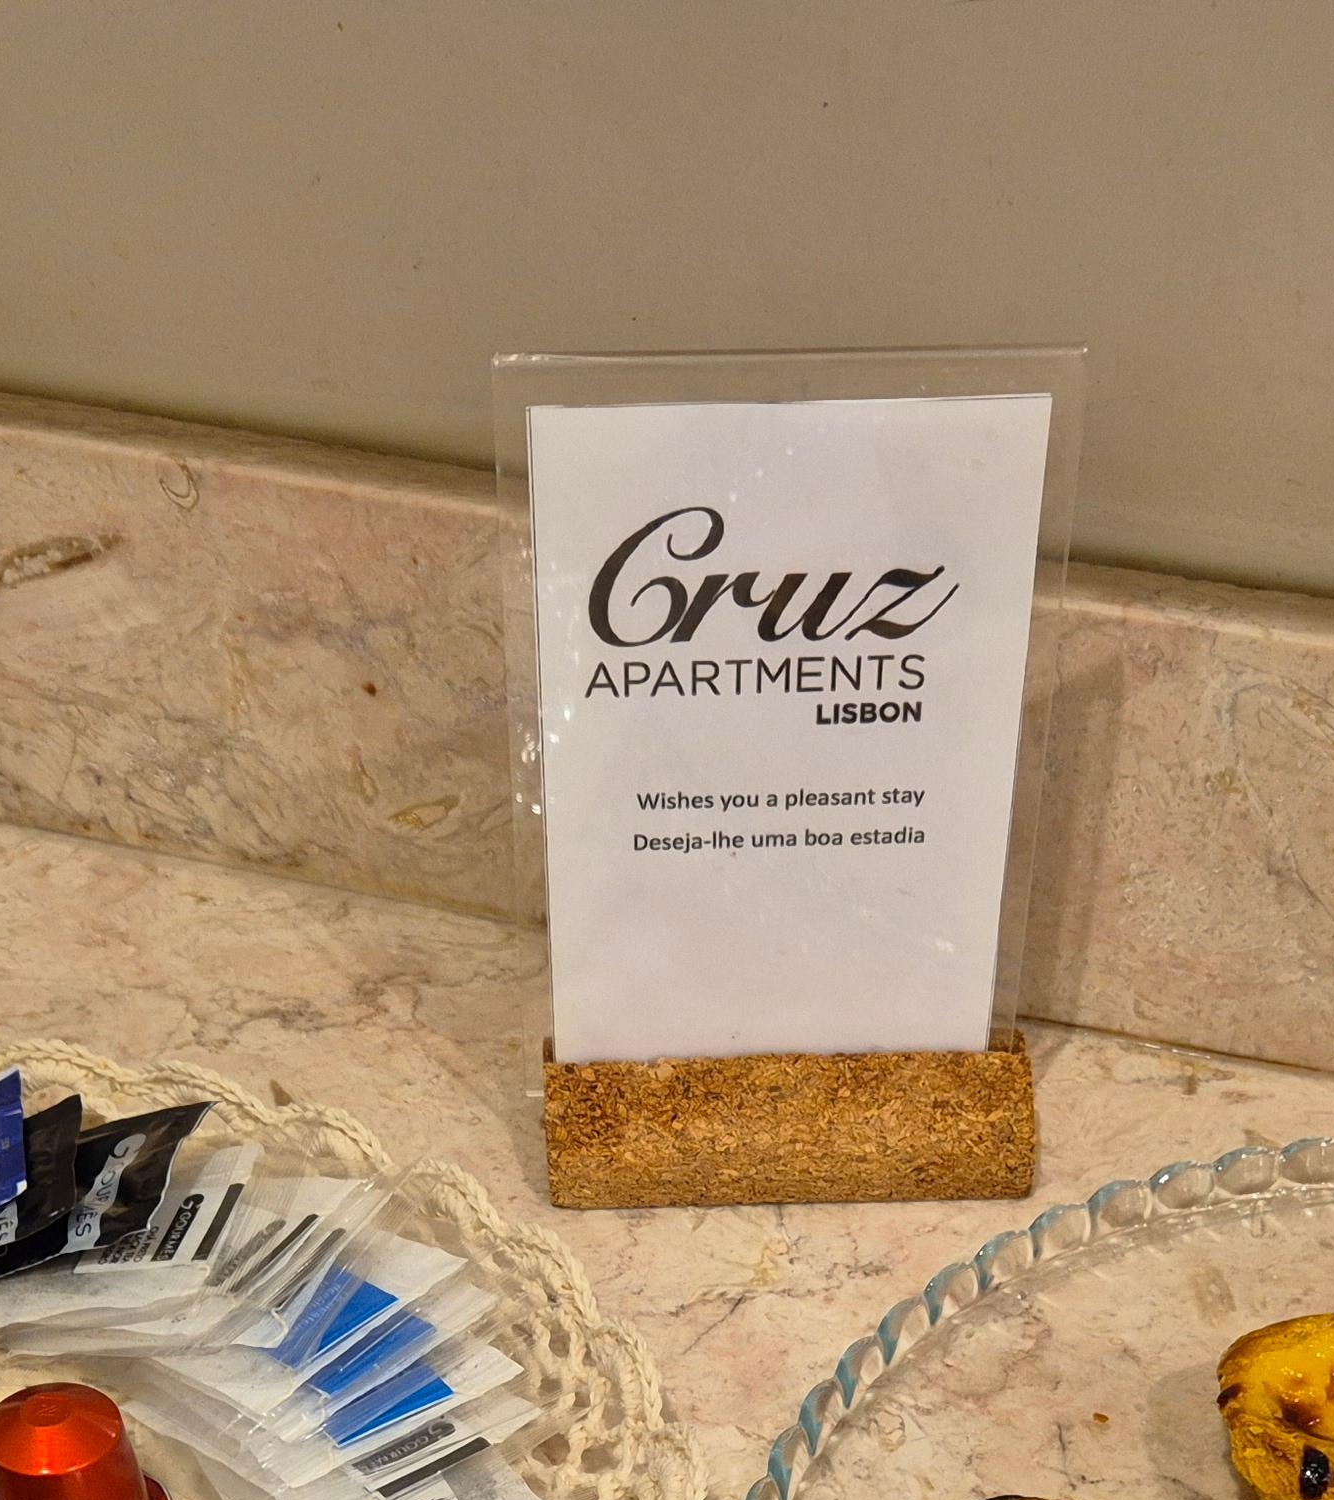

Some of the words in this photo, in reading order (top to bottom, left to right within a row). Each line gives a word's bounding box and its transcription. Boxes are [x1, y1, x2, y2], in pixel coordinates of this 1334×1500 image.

[588, 506, 960, 648] Cruz
[584, 654, 925, 699] APARTMENTS
[816, 701, 922, 725] LISBON
[637, 791, 714, 810] Wishes
[720, 793, 759, 812] you
[766, 794, 778, 807] a
[785, 788, 875, 811] pleasant
[881, 788, 924, 808] stay
[633, 831, 744, 854] Deseja-lhe
[751, 832, 797, 849] uma
[805, 828, 842, 847] boa
[850, 826, 925, 846] estadia
